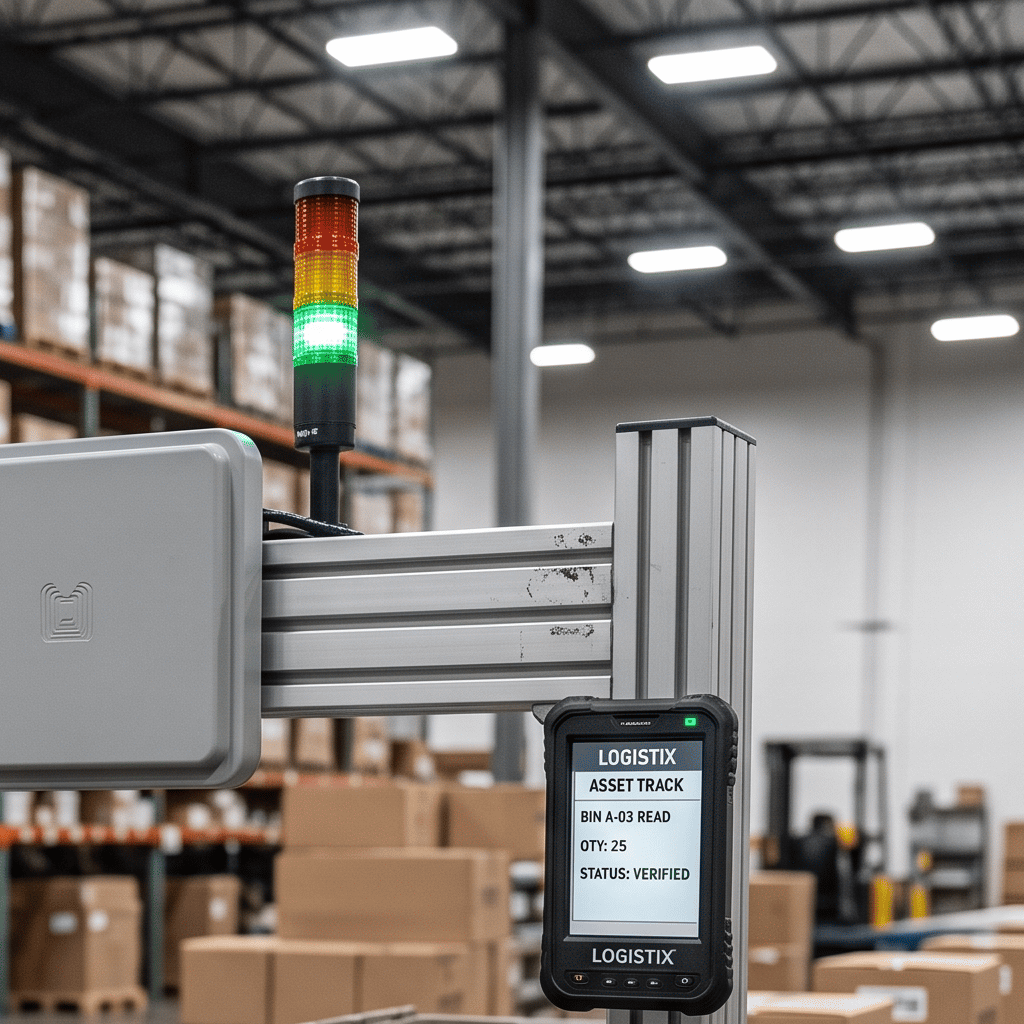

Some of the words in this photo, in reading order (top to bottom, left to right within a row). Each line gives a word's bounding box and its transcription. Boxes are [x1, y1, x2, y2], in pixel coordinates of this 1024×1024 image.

[599, 748, 677, 766] LOGISTIX
[589, 778, 634, 792] ASSET
[637, 777, 684, 792] TRACK
[580, 810, 602, 823] BIN
[605, 810, 634, 823] A-03
[637, 810, 671, 823] READ
[611, 839, 627, 852] 25
[580, 867, 630, 880] STATUS:
[633, 867, 690, 881] VERIFIED
[592, 948, 676, 965] LOGISTIX
